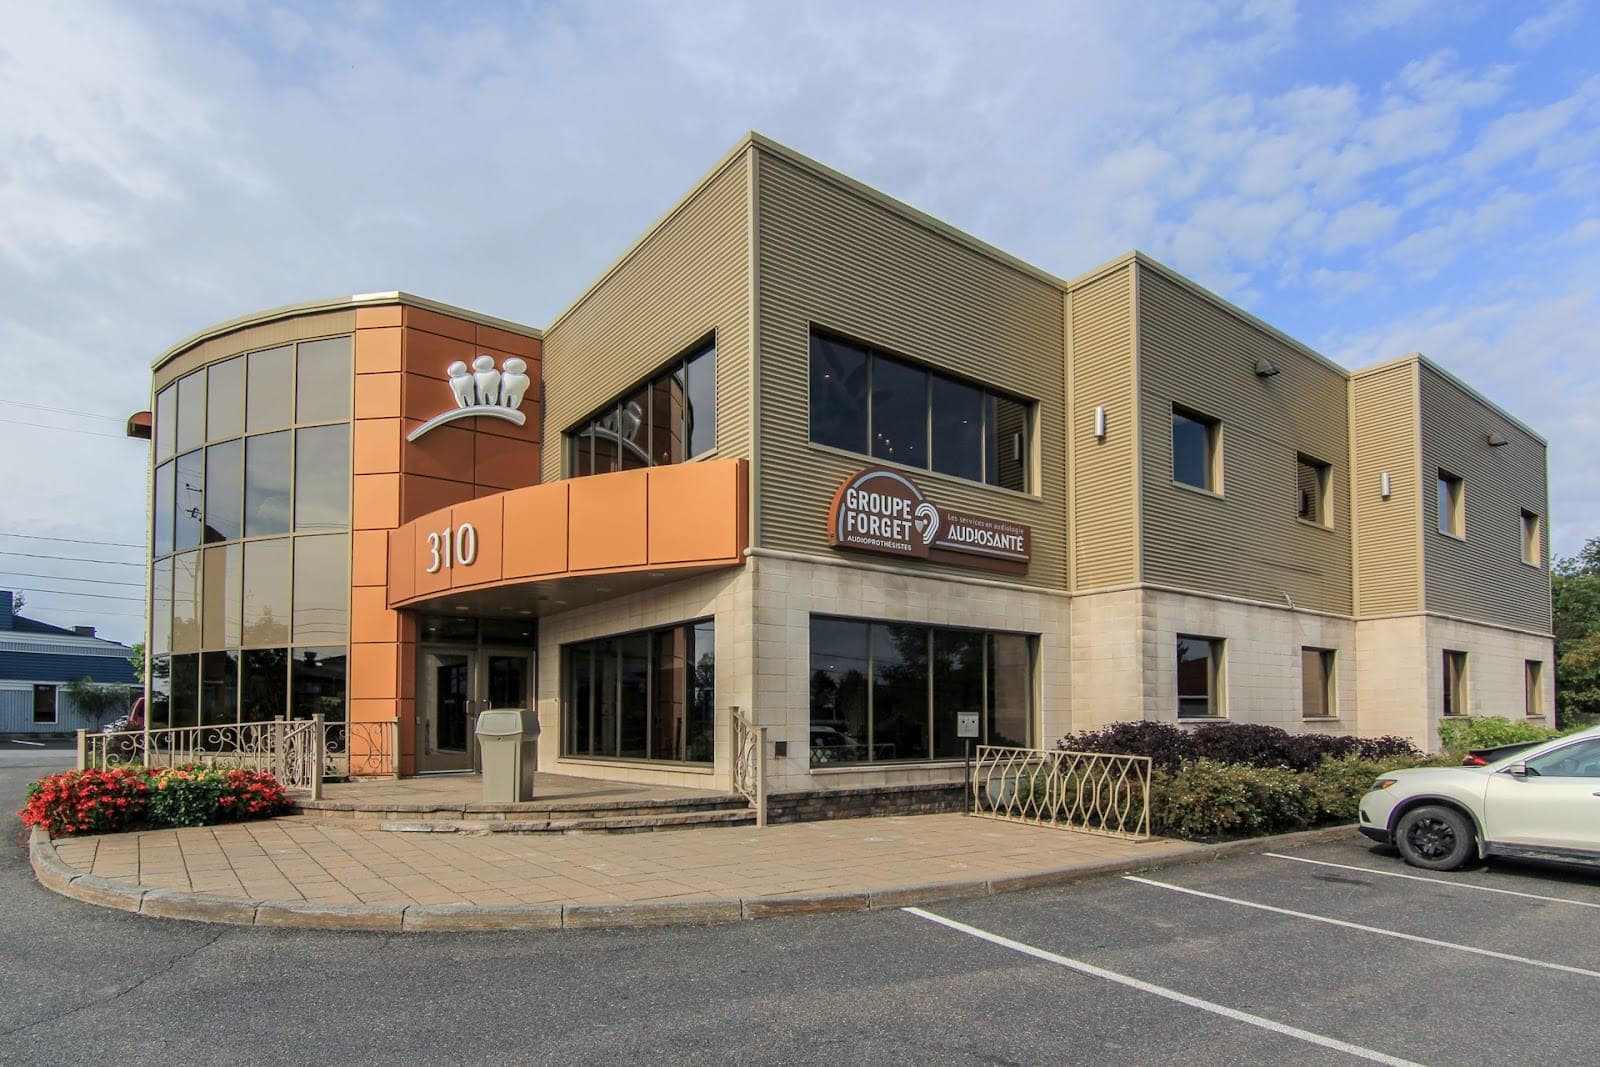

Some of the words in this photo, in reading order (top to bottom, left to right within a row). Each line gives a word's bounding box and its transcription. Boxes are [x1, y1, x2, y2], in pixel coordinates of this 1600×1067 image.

[846, 488, 912, 520] GROUPE
[847, 511, 912, 541] FORGET
[947, 513, 958, 522] Les
[959, 517, 985, 527] services
[994, 523, 1024, 535] audiologie
[426, 522, 476, 573] 310
